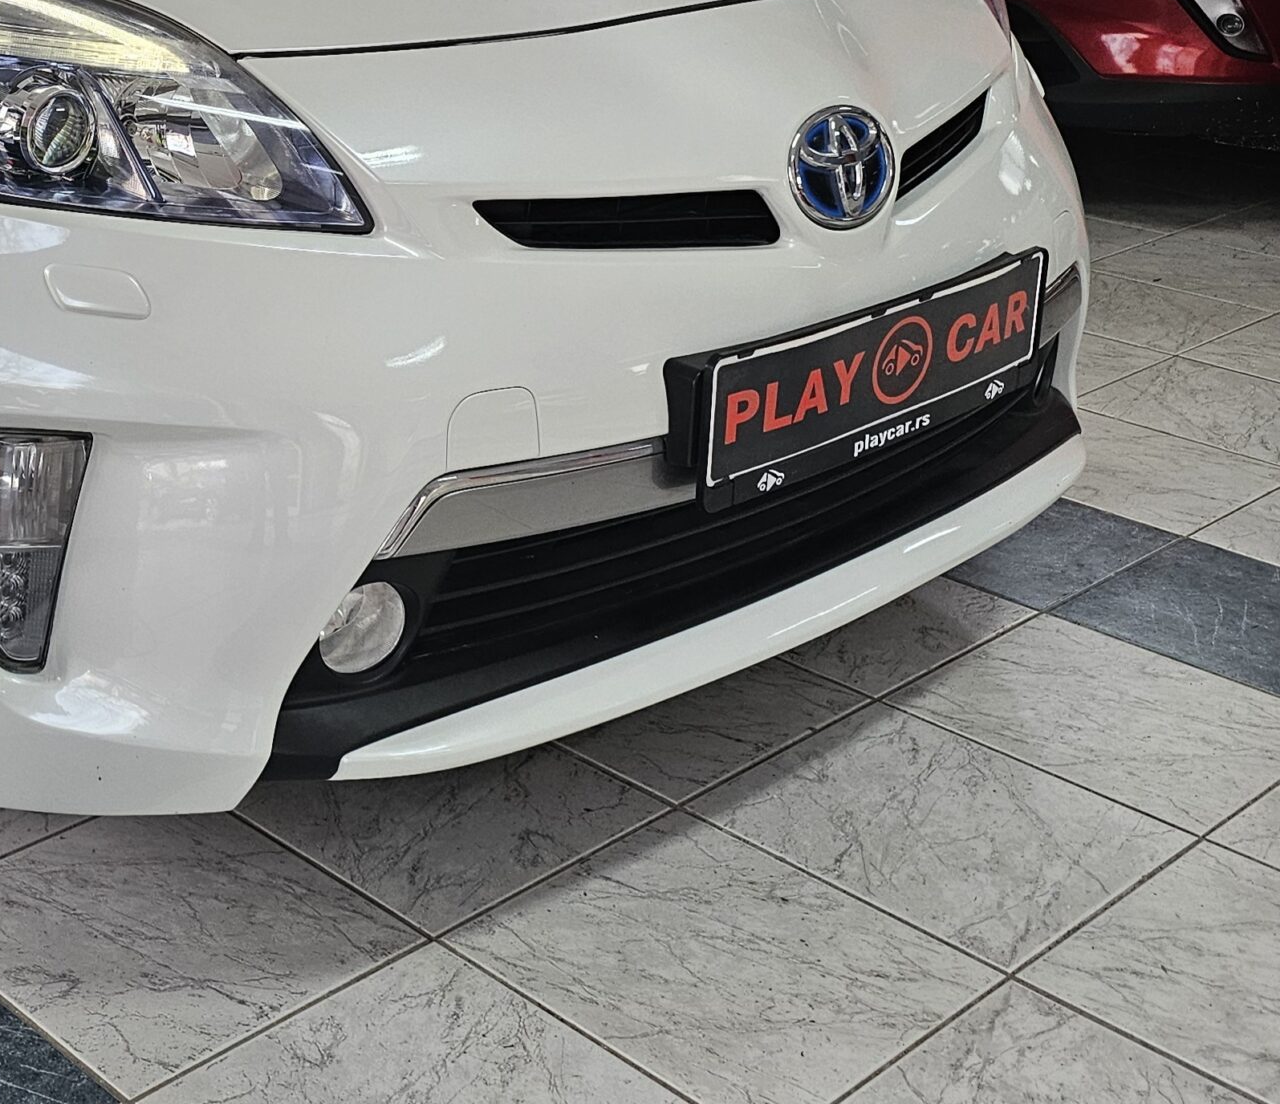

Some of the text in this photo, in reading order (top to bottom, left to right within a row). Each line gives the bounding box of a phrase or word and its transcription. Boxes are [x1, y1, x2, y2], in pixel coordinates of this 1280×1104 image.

[724, 290, 1030, 445] PLAY CAR
[853, 412, 931, 457] playcar.rs
